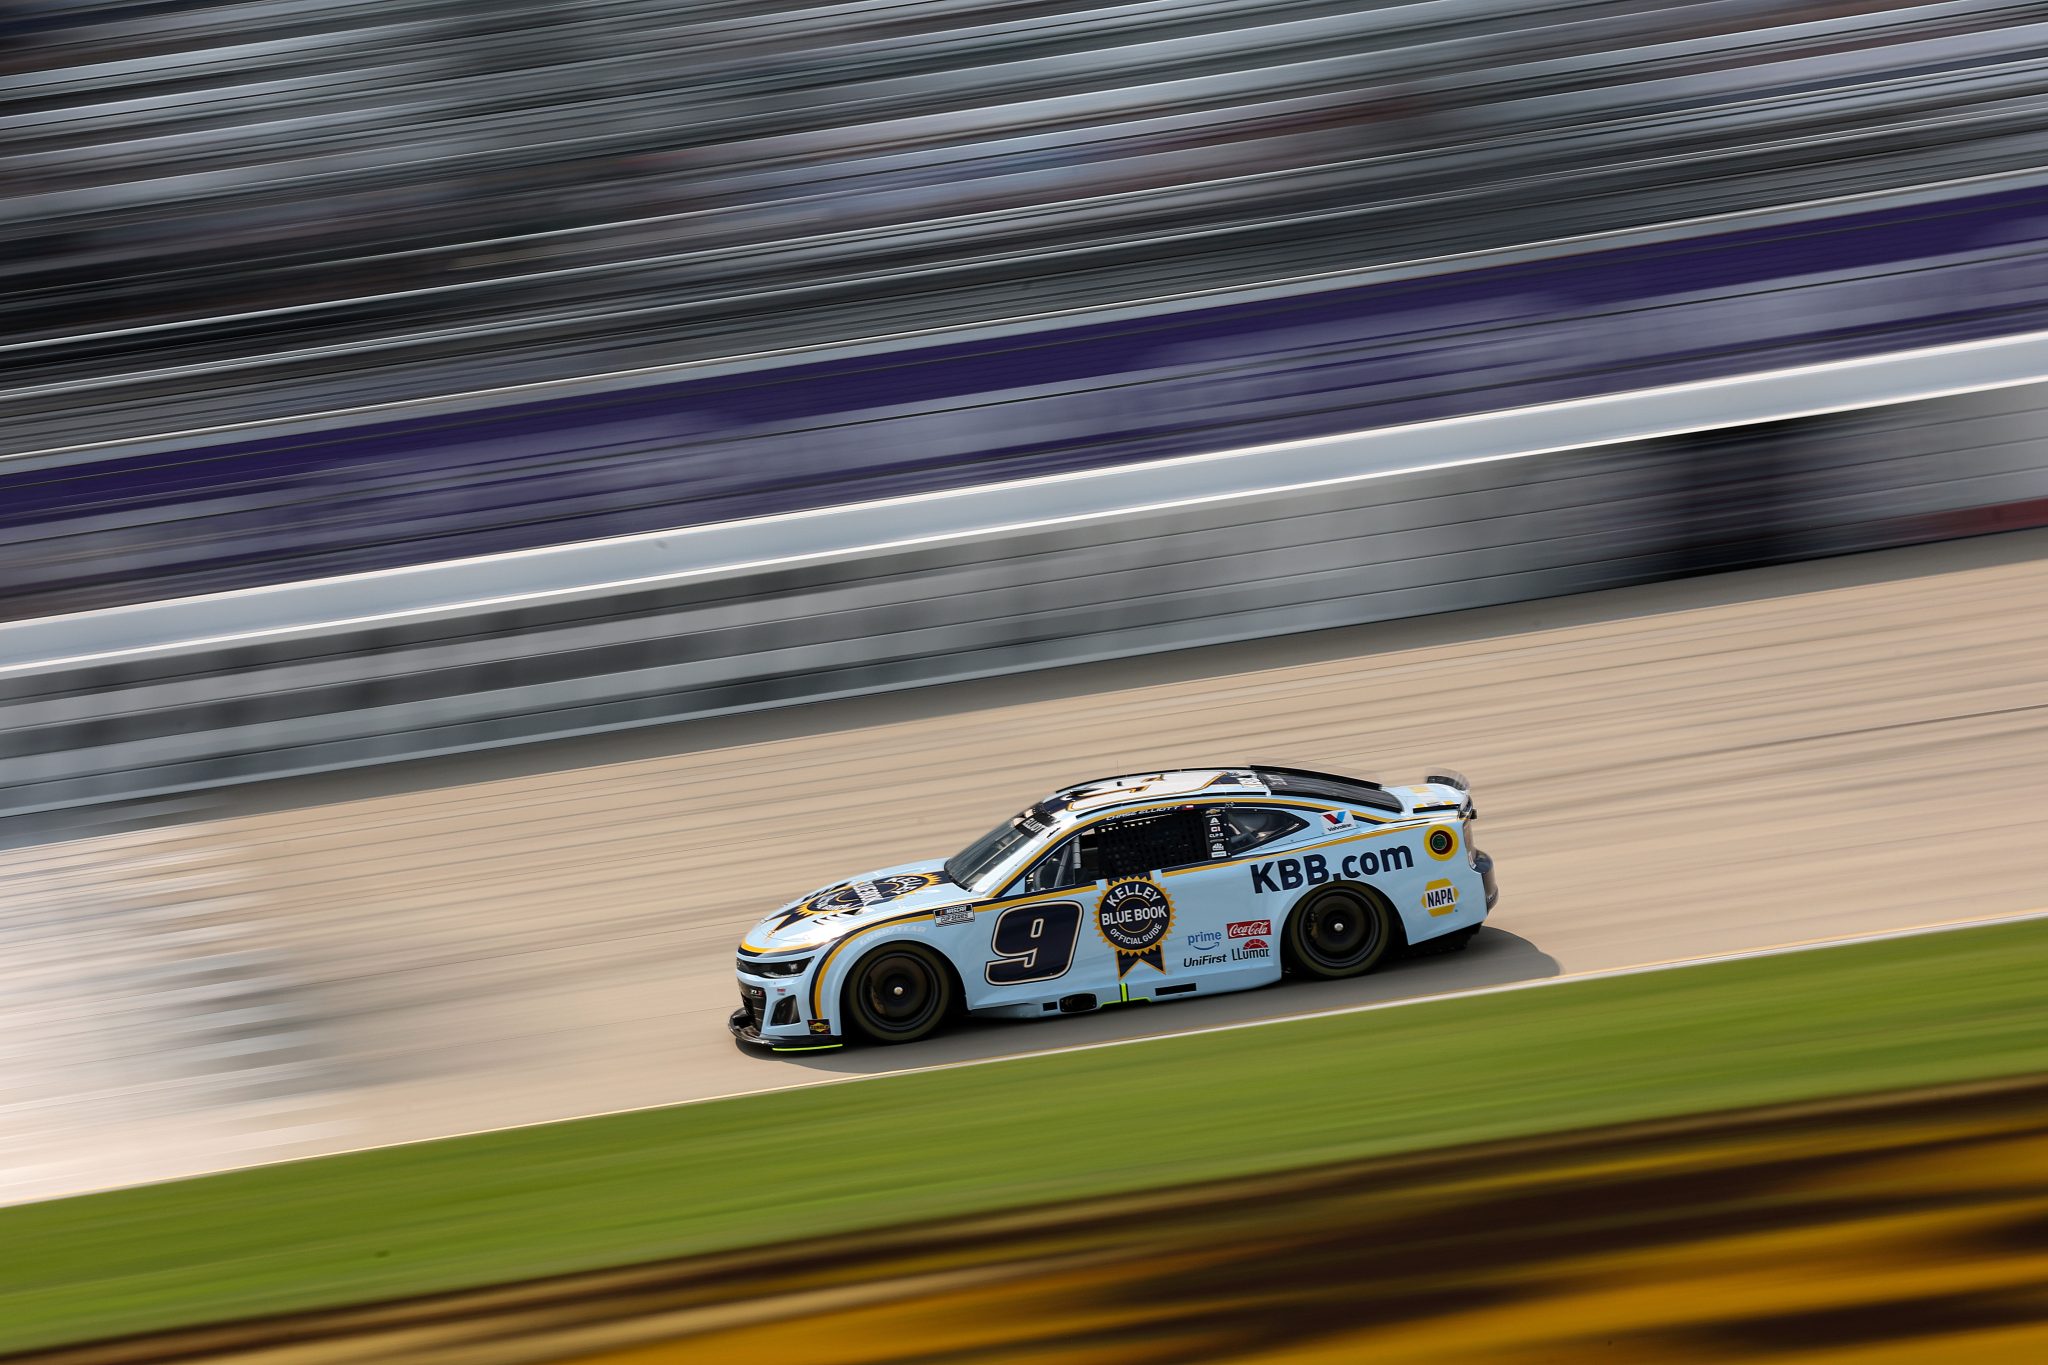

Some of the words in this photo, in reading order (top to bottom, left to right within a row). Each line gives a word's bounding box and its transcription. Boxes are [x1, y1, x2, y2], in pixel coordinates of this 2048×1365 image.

[1250, 844, 1414, 894] KBB.com
[1106, 884, 1161, 907] KELLEY
[1426, 887, 1454, 908] NAPA
[1101, 910, 1133, 926] BLUE
[1134, 905, 1168, 921] BOOK
[984, 900, 1084, 986] 9
[1110, 928, 1143, 945] OFFICIAL
[1142, 922, 1162, 942] GUIDE
[1187, 931, 1222, 946] prime
[1183, 953, 1228, 967] UniFirst
[1231, 947, 1270, 961] LLumar
